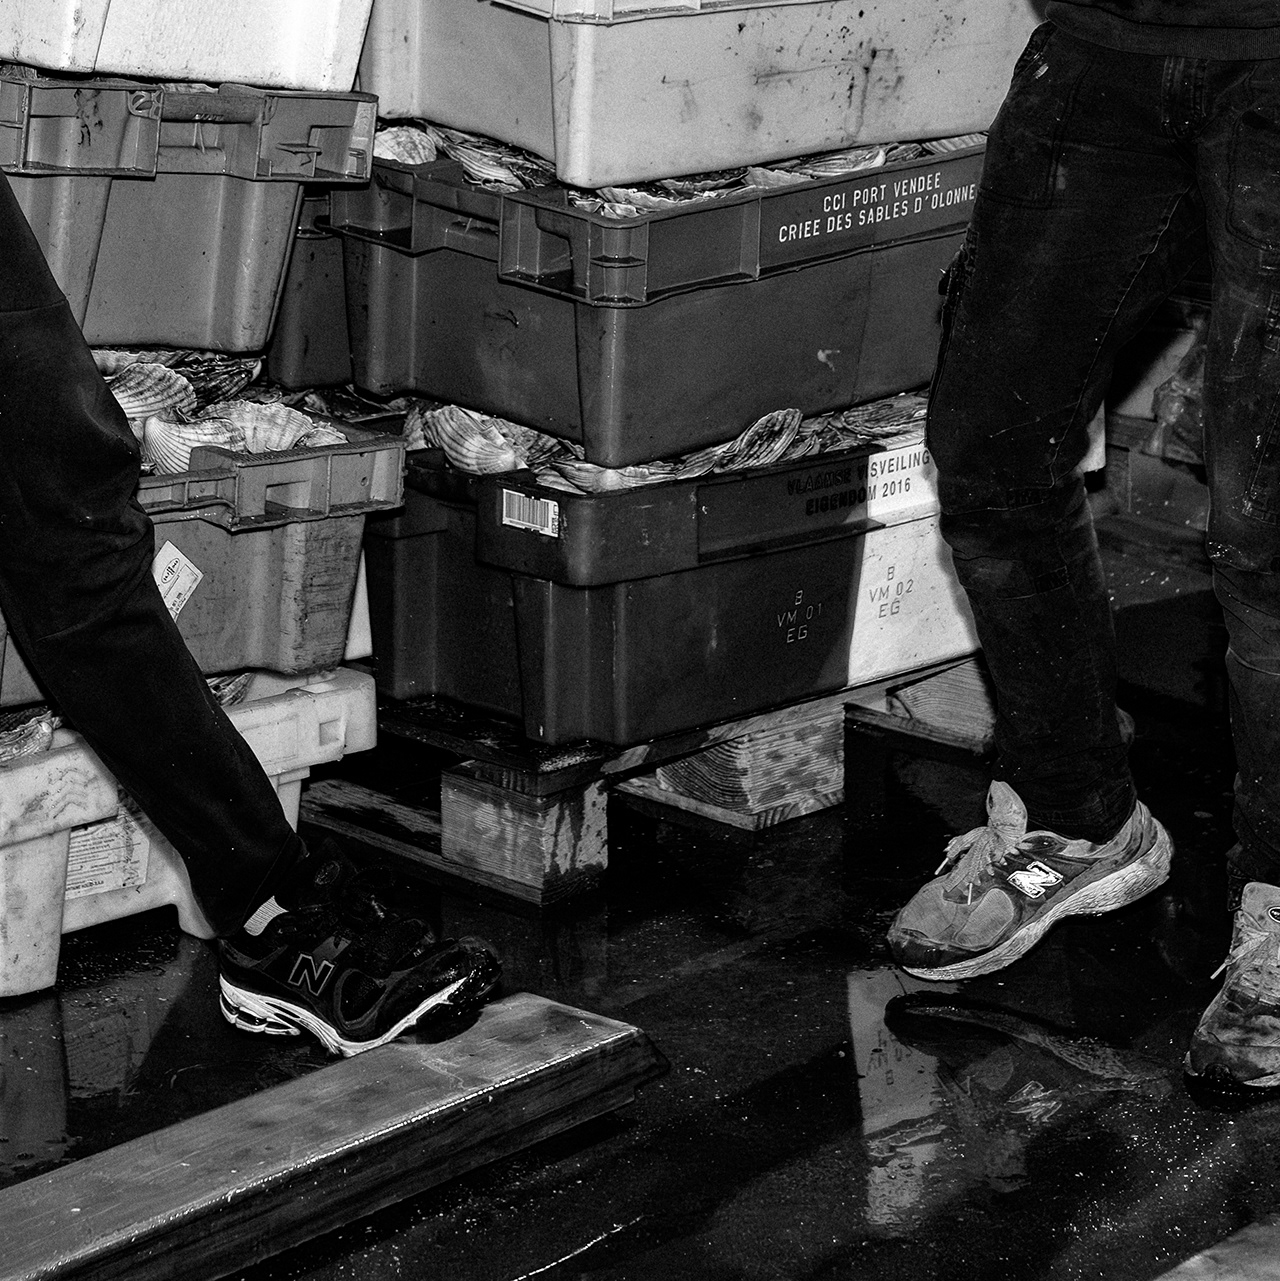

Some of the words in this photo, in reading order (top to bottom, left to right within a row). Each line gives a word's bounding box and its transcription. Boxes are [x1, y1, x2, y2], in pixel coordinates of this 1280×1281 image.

[823, 193, 846, 212] CCI
[853, 184, 887, 207] PORT
[894, 172, 941, 198] VENDEE
[779, 219, 821, 243] CRIEE
[826, 213, 852, 234] DES
[858, 197, 908, 226] SABLES
[857, 449, 930, 482] VISVEILING
[805, 485, 877, 516] EIGENDOM
[882, 477, 911, 498] 2016
[887, 565, 895, 581] B
[794, 590, 803, 606] B
[869, 585, 890, 602] VM
[896, 578, 914, 596] 02
[777, 610, 798, 628] VM
[806, 603, 822, 620] 01
[878, 600, 901, 618] EG
[786, 625, 808, 643] EG
[1006, 860, 1064, 899] N
[288, 953, 335, 996] N
